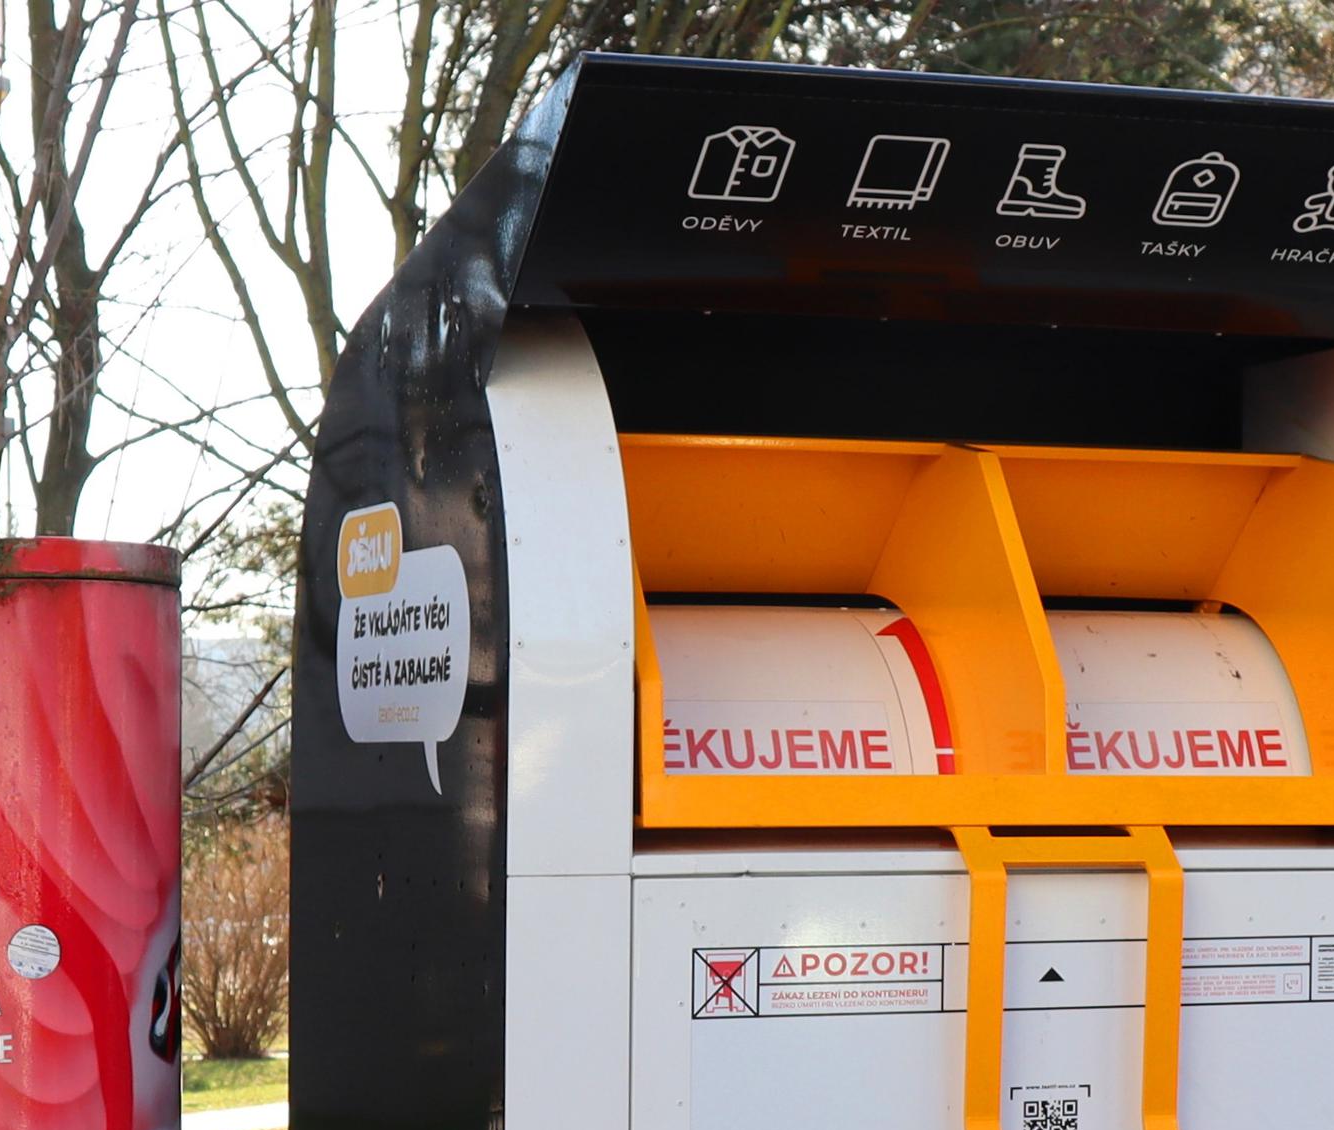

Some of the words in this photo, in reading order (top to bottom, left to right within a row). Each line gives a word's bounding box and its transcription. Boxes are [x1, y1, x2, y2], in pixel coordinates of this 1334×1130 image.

[682, 215, 763, 233] ODĚVY
[841, 224, 912, 241] TEXTIL
[995, 234, 1060, 250] OBUV
[1139, 241, 1207, 257] TAŠKY
[354, 607, 365, 639] ŽE
[368, 599, 421, 638] VKLÁDÁTE
[424, 595, 449, 631] VĚCI
[352, 652, 381, 690] ČISTÉ
[384, 662, 392, 687] A
[394, 647, 451, 686] ZABALENÉ
[1067, 722, 1288, 770] ĚKUJEME
[801, 951, 928, 977] POZOR!
[771, 991, 804, 1001] ZÁKAZ
[807, 990, 841, 1000] LEZENÍ
[844, 990, 859, 999] DO
[861, 989, 928, 998] KONTEJNERU!
